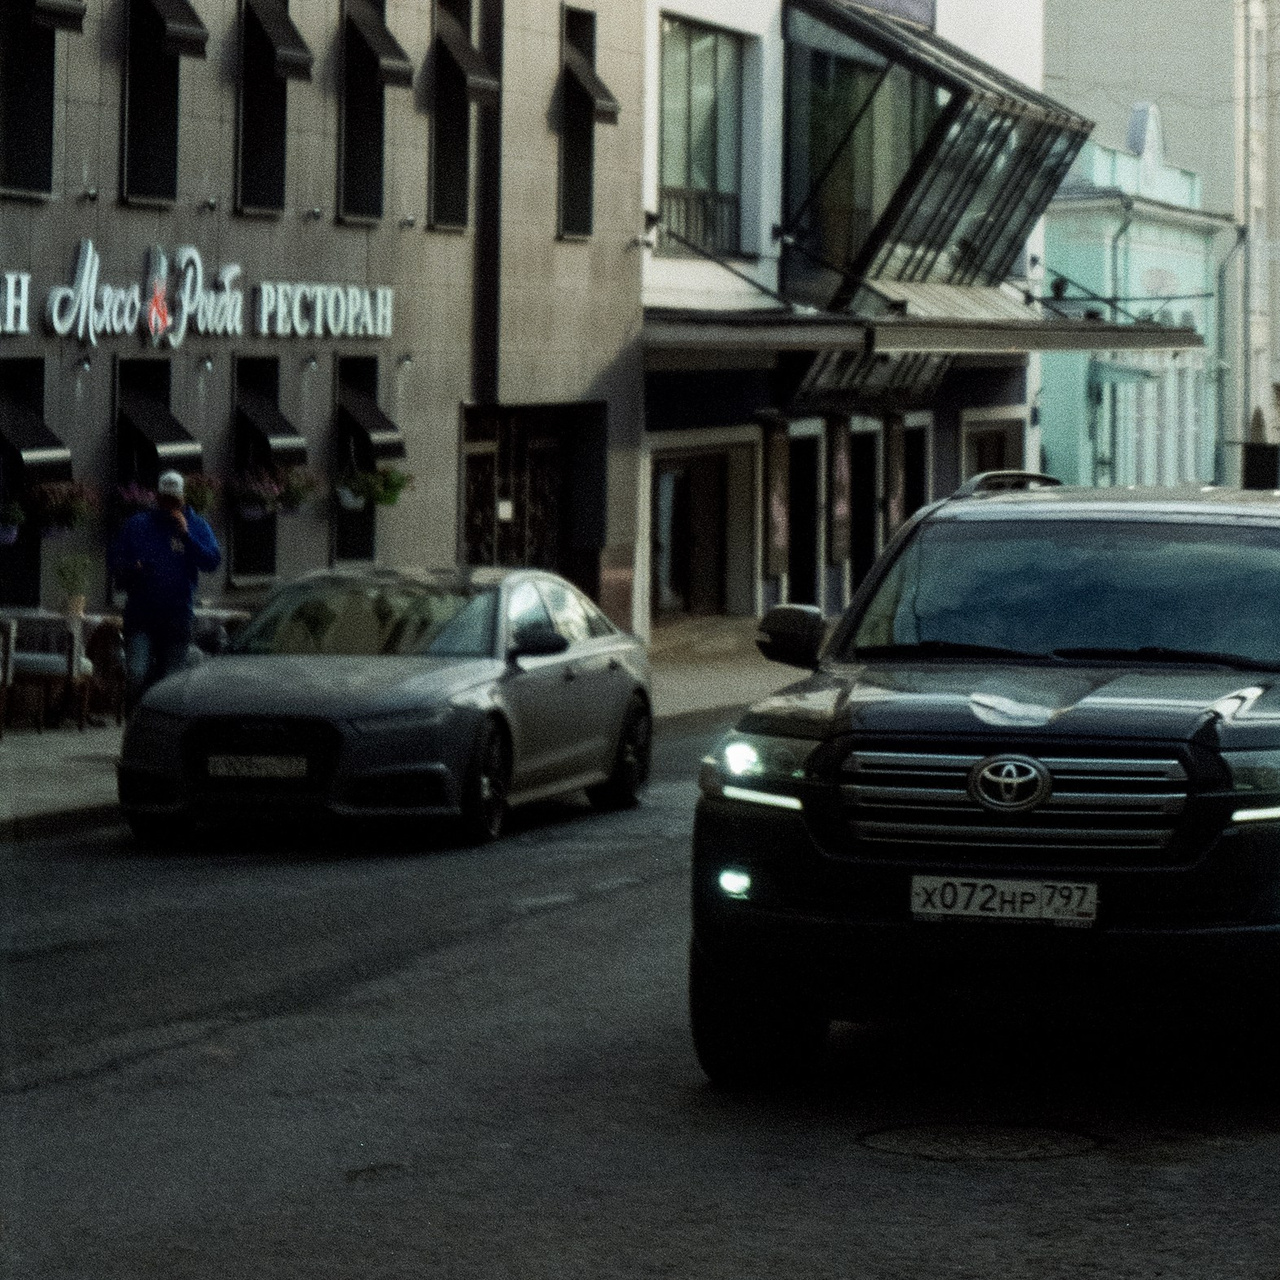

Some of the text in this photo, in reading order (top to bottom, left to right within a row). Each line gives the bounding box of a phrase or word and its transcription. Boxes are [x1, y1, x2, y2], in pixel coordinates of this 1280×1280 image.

[0, 273, 31, 335] Н
[260, 282, 393, 337] РЕСТОРАН
[1044, 884, 1088, 909] 797
